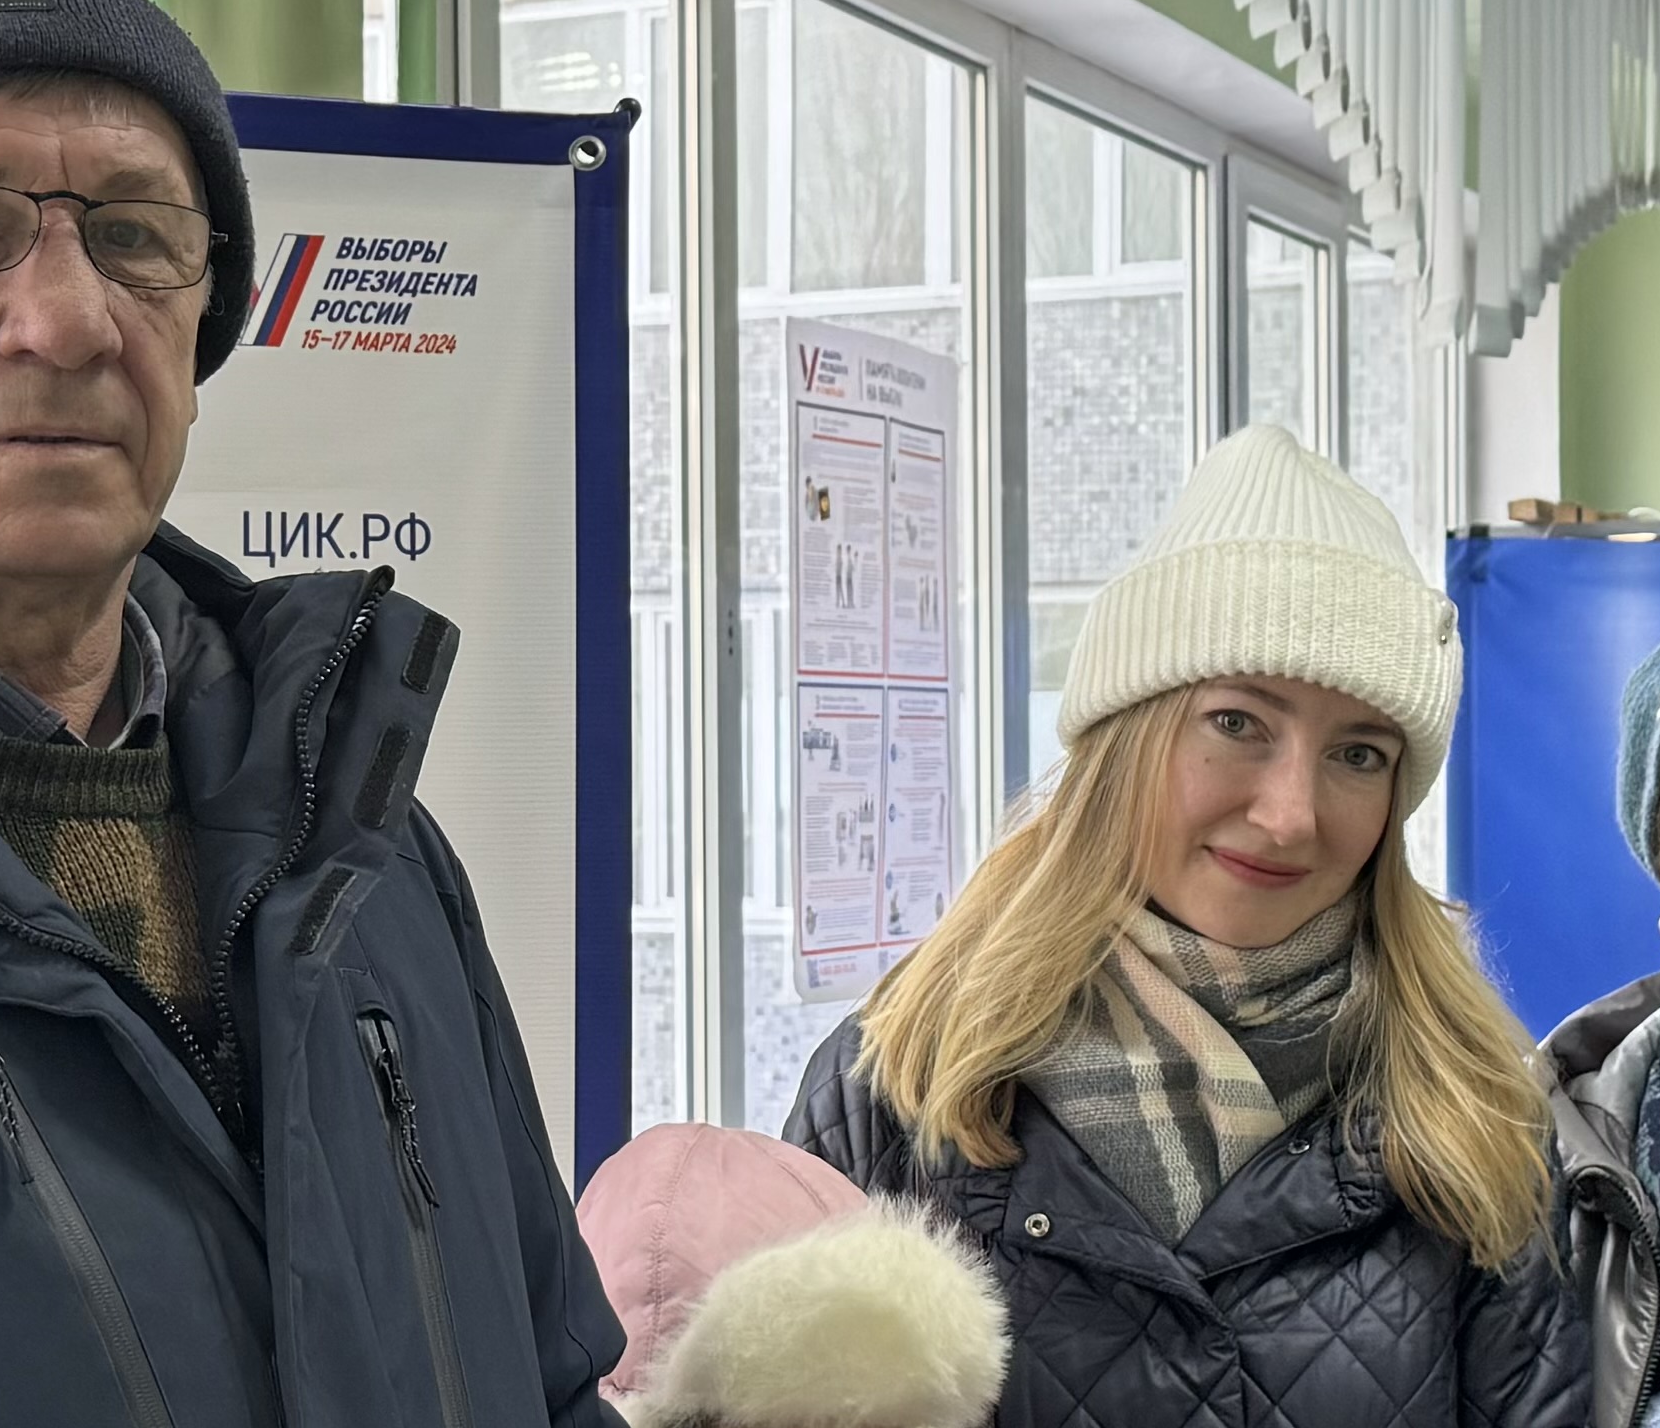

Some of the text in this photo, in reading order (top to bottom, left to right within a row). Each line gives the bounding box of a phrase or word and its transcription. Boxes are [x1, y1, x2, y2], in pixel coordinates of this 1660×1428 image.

[335, 236, 448, 265] ВЫБОРЫ
[322, 267, 479, 299] ПРЕЗИДЕНТА
[310, 298, 413, 326] РОССИИ
[351, 330, 413, 354] МАРТА
[413, 333, 457, 355] 2024
[241, 510, 432, 569] ЦИК.РФ
